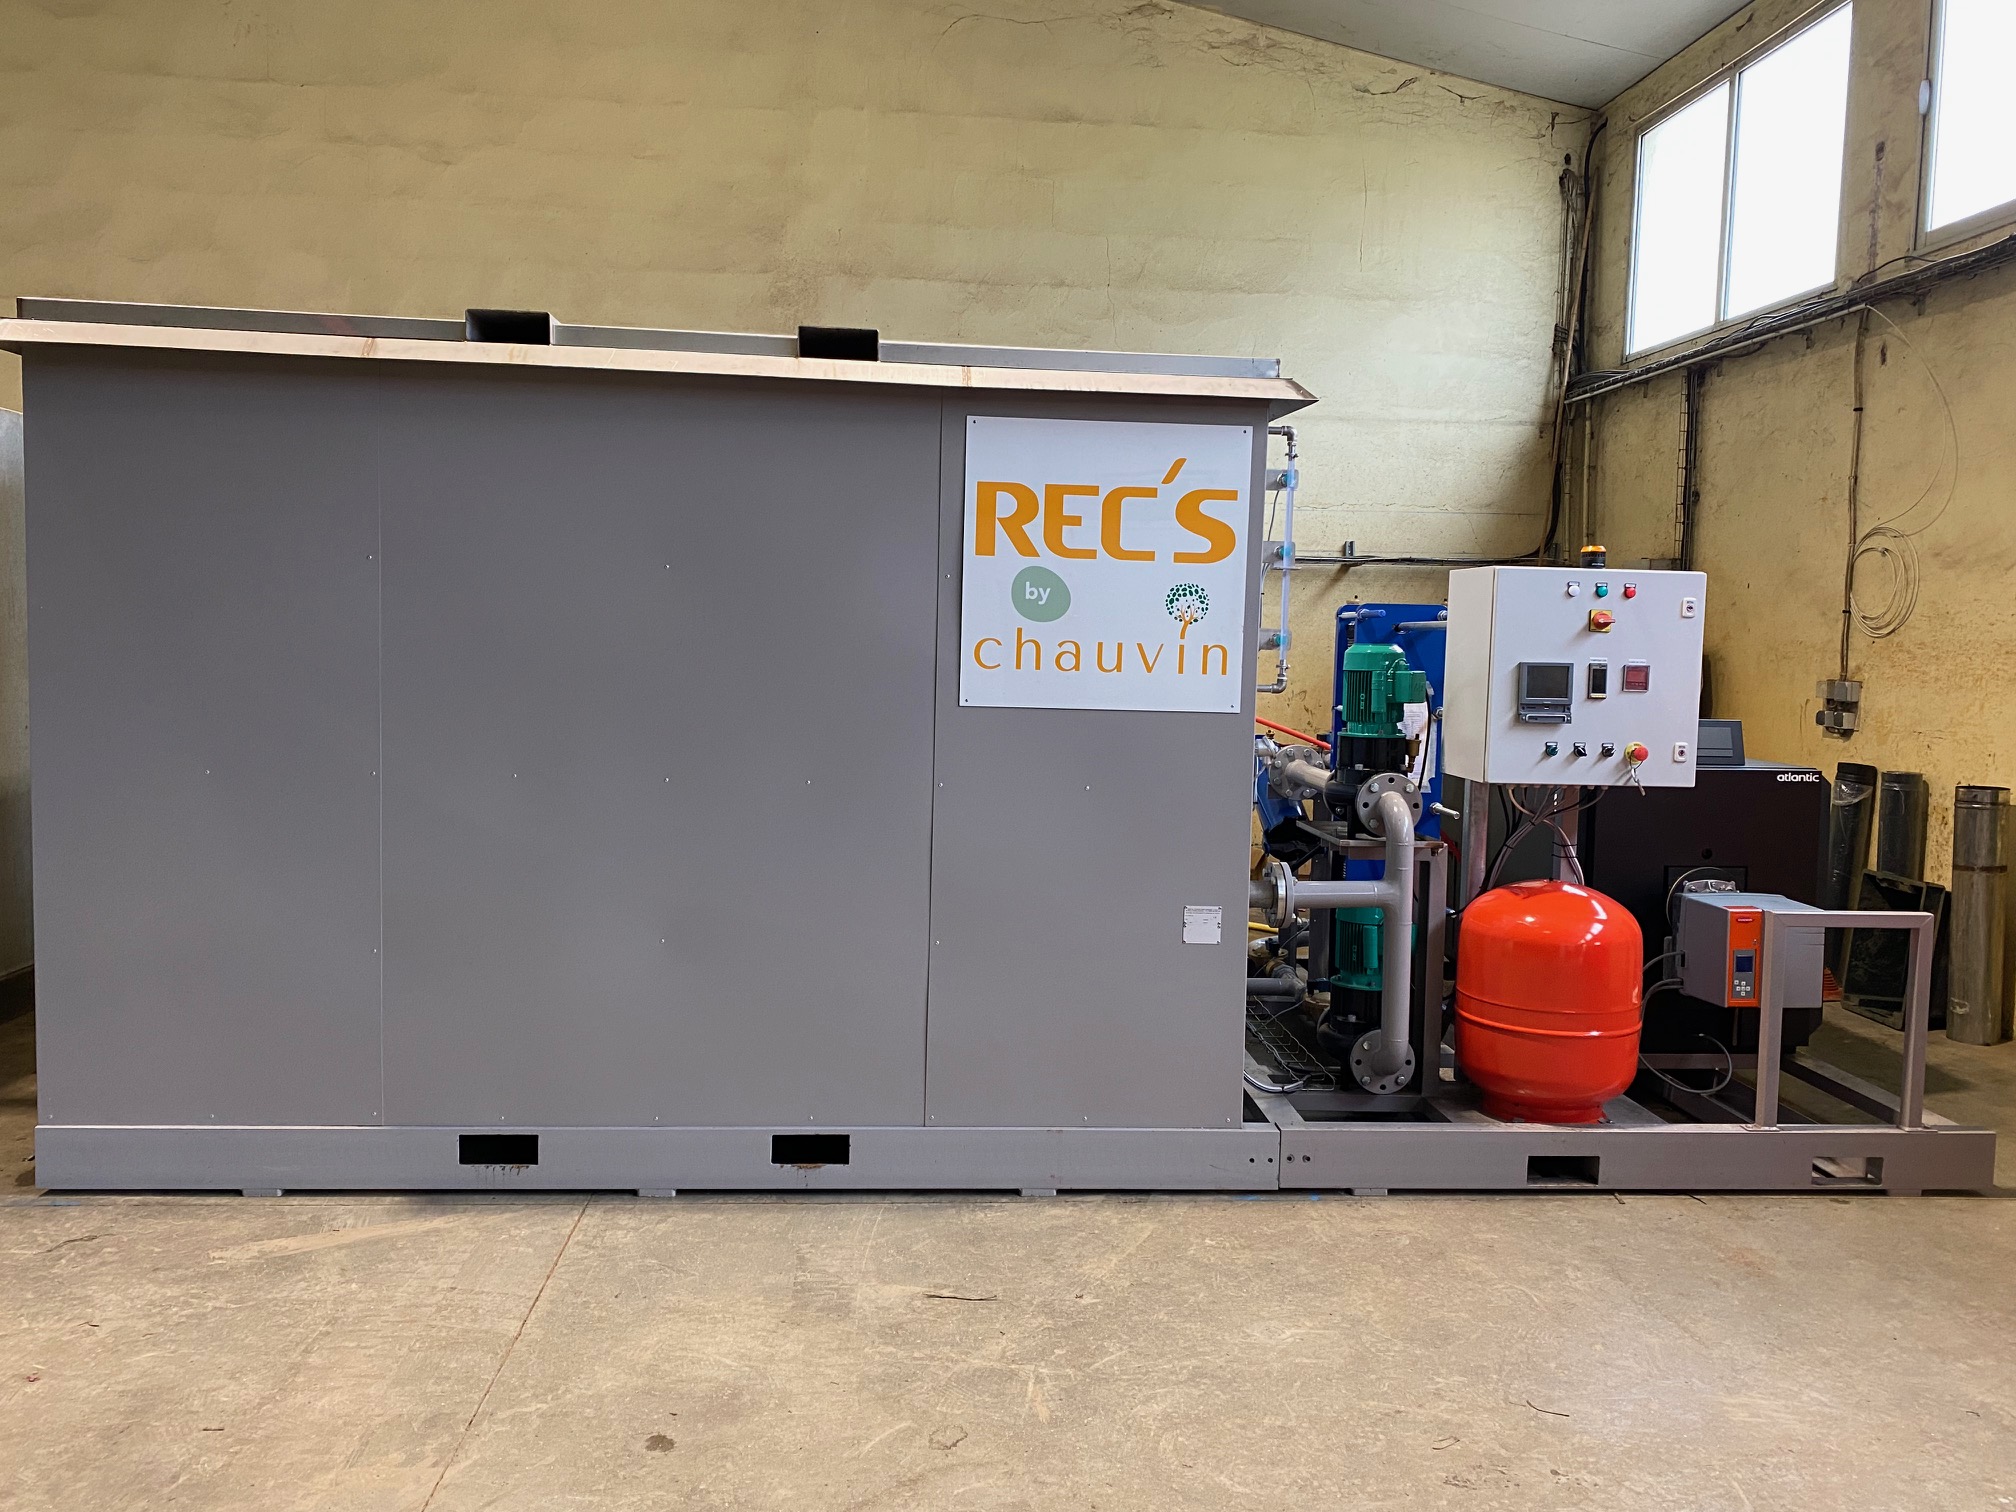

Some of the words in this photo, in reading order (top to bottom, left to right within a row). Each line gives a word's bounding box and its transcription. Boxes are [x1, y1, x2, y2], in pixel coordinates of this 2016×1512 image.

[1025, 582, 1051, 605] by
[974, 628, 1228, 675] chauvin
[1776, 772, 1820, 782] atlantic
